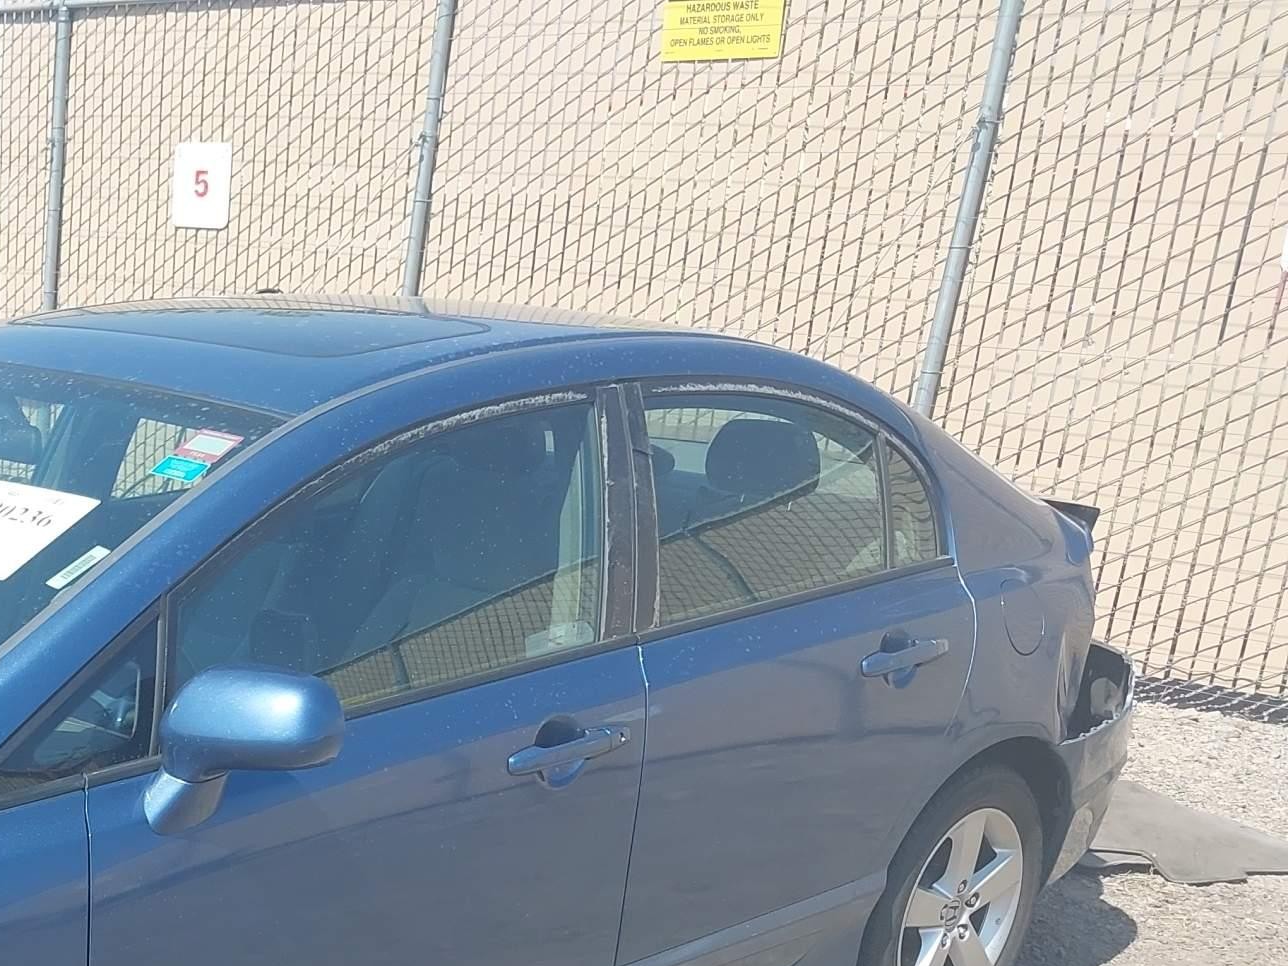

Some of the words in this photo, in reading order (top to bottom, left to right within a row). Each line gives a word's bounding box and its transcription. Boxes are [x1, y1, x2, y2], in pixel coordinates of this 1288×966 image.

[686, 2, 731, 13] HAZARDOUS
[732, 0, 759, 10] WASTE
[679, 15, 711, 25] MATERIAL
[713, 13, 744, 24] STORAGE
[745, 12, 765, 22] ONLY
[698, 26, 709, 35] NO
[709, 25, 742, 34] SMOKING,
[670, 38, 688, 47] OPEN
[688, 37, 714, 46] FLAMES
[715, 36, 725, 45] OR
[726, 35, 745, 45] OPEN
[746, 33, 771, 43] LIGHTS
[194, 170, 209, 198] 5
